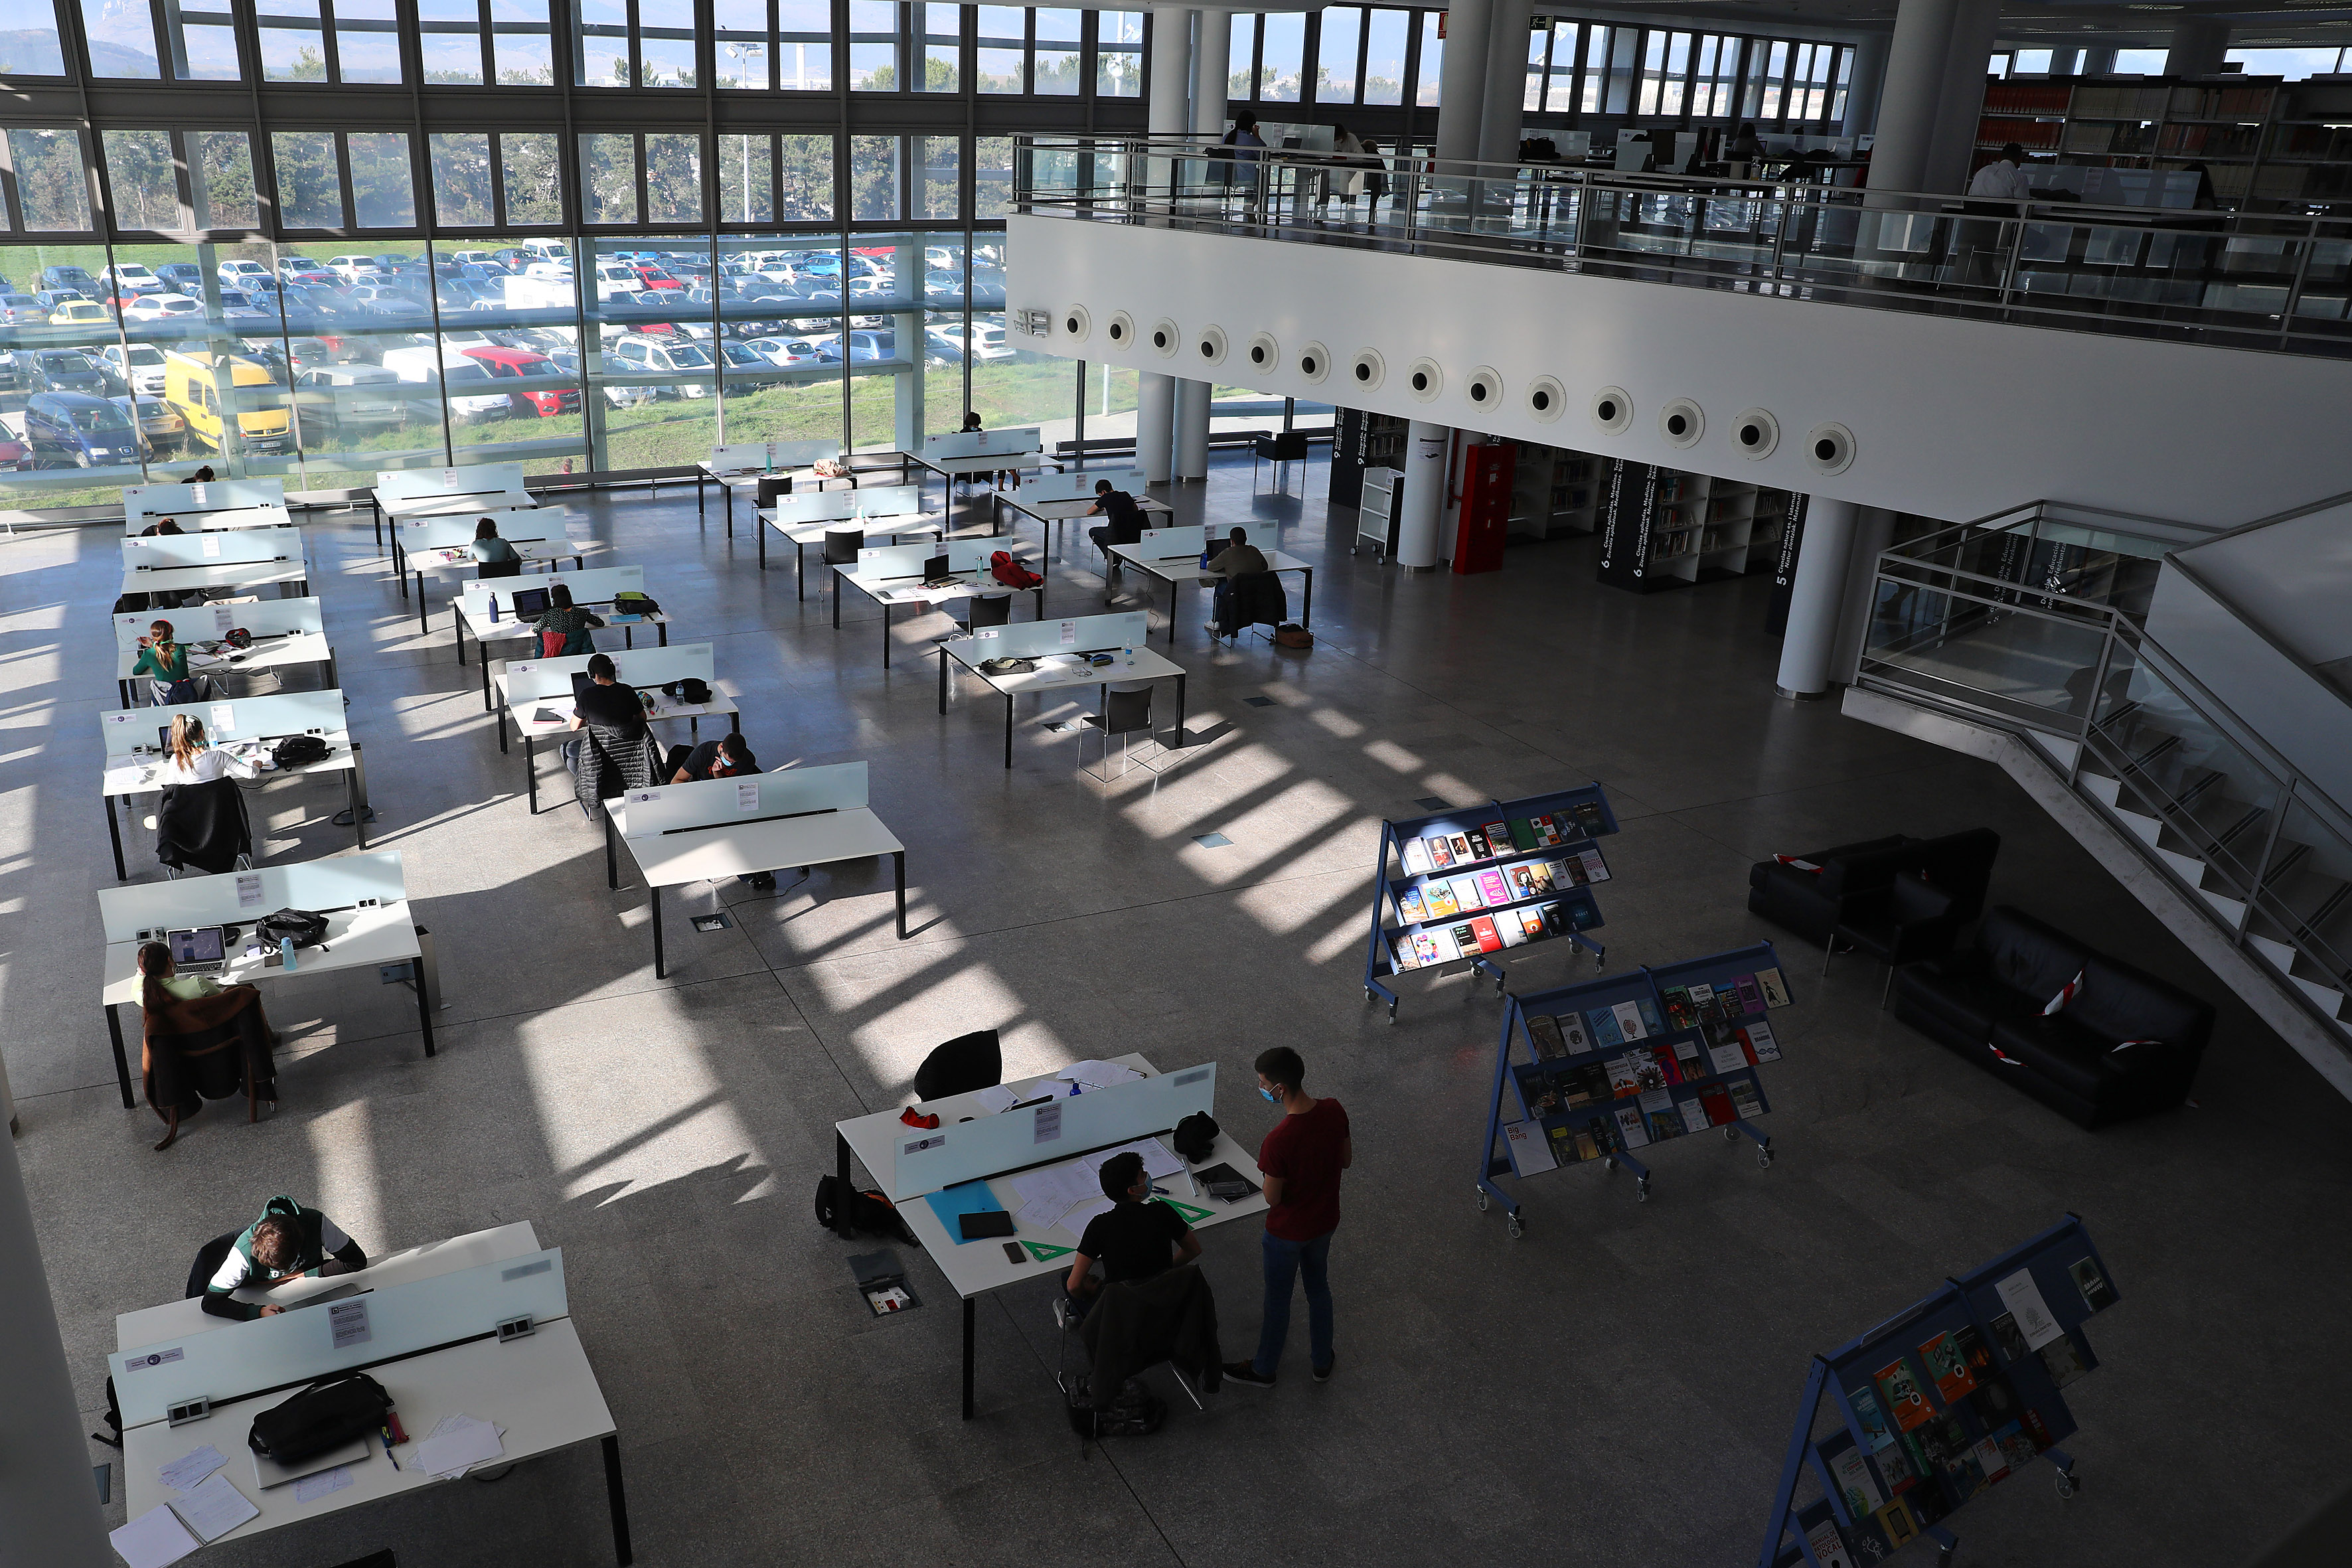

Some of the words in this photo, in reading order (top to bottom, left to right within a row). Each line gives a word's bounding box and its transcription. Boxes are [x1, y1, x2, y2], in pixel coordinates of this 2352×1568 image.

[1788, 523, 1796, 550] zientziak.
[1778, 550, 1786, 573] Ciencias
[1783, 521, 1792, 549] naturaes.
[1776, 576, 1787, 586] 5
[1812, 1534, 1830, 1547] MANUAL
[1816, 1541, 1842, 1560] VOCAL
